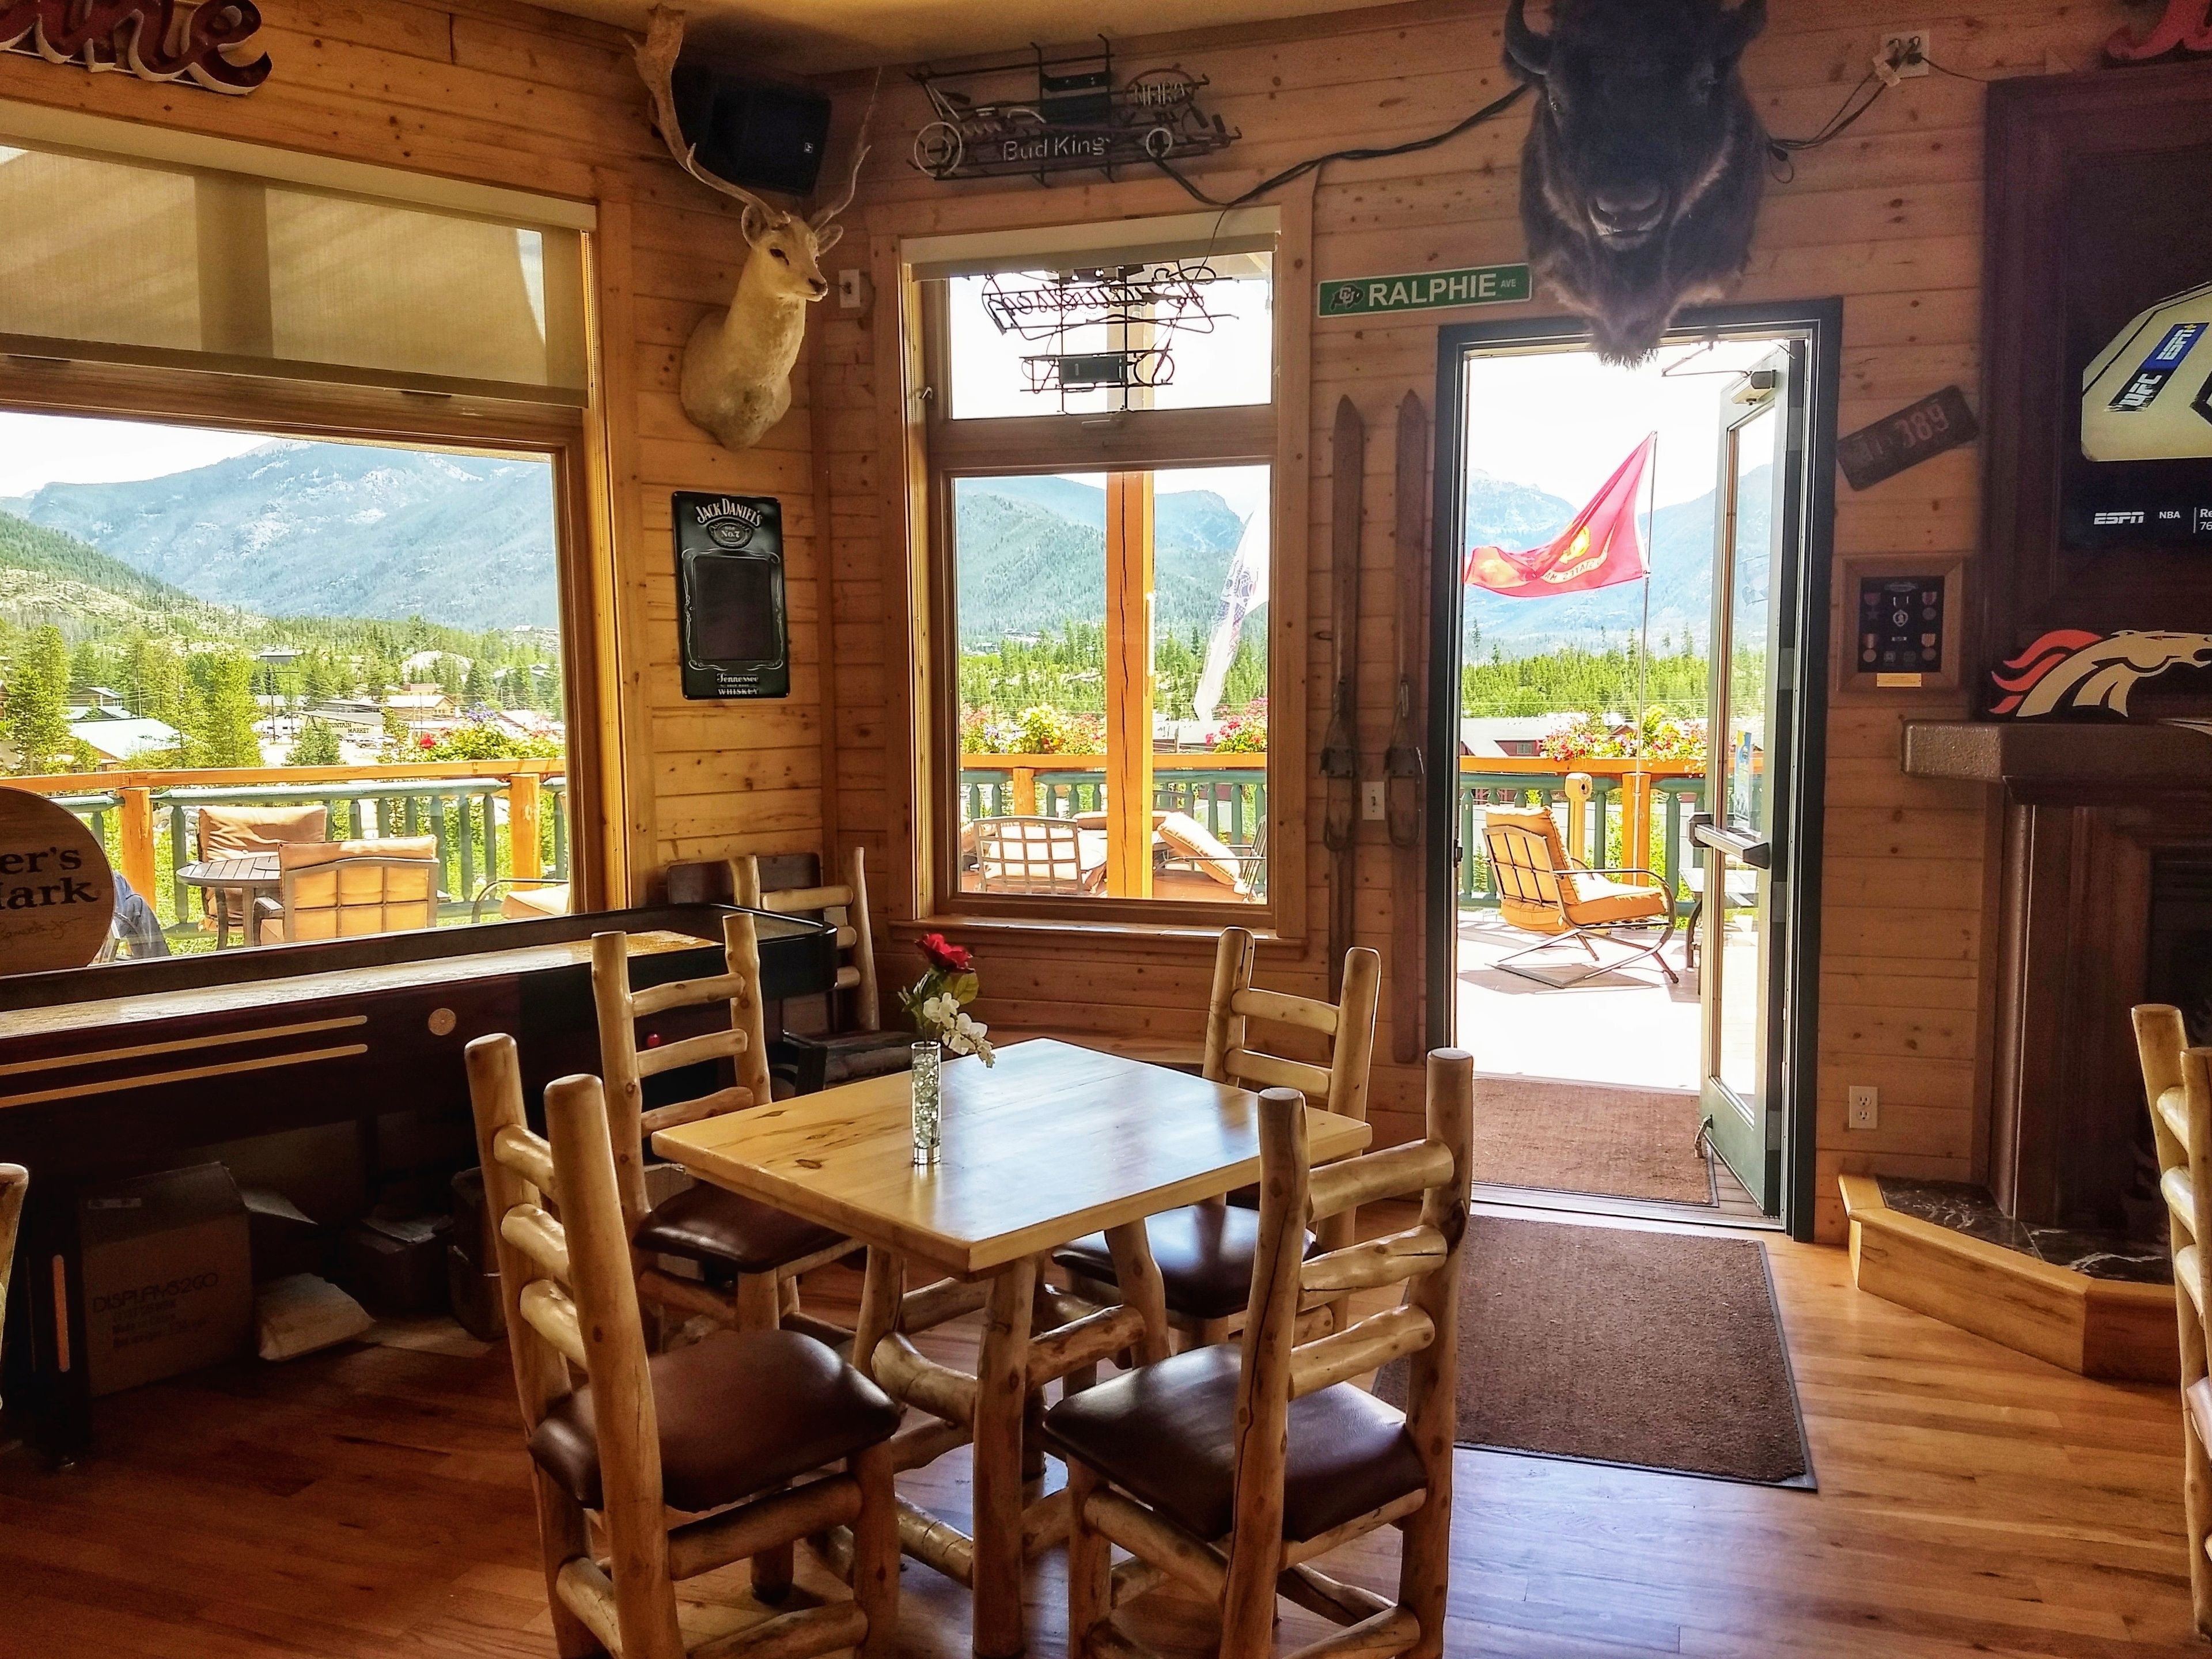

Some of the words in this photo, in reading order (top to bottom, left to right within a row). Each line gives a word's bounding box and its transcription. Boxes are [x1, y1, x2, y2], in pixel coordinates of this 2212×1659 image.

[1003, 139, 1048, 161] Bud
[1055, 135, 1105, 156] King
[1369, 273, 1497, 306] RALPHIE
[1500, 279, 1516, 288] AVE
[2118, 373, 2163, 406] UFC
[695, 502, 722, 524] JACK
[721, 498, 763, 527] DANIEL'S
[2094, 511, 2145, 525] ESPN
[2159, 511, 2181, 519] NBA
[717, 673, 759, 683] Tennessee
[0, 847, 82, 875] er's
[0, 877, 99, 911] ark
[93, 1272, 219, 1313] DISPLAYS2GO
